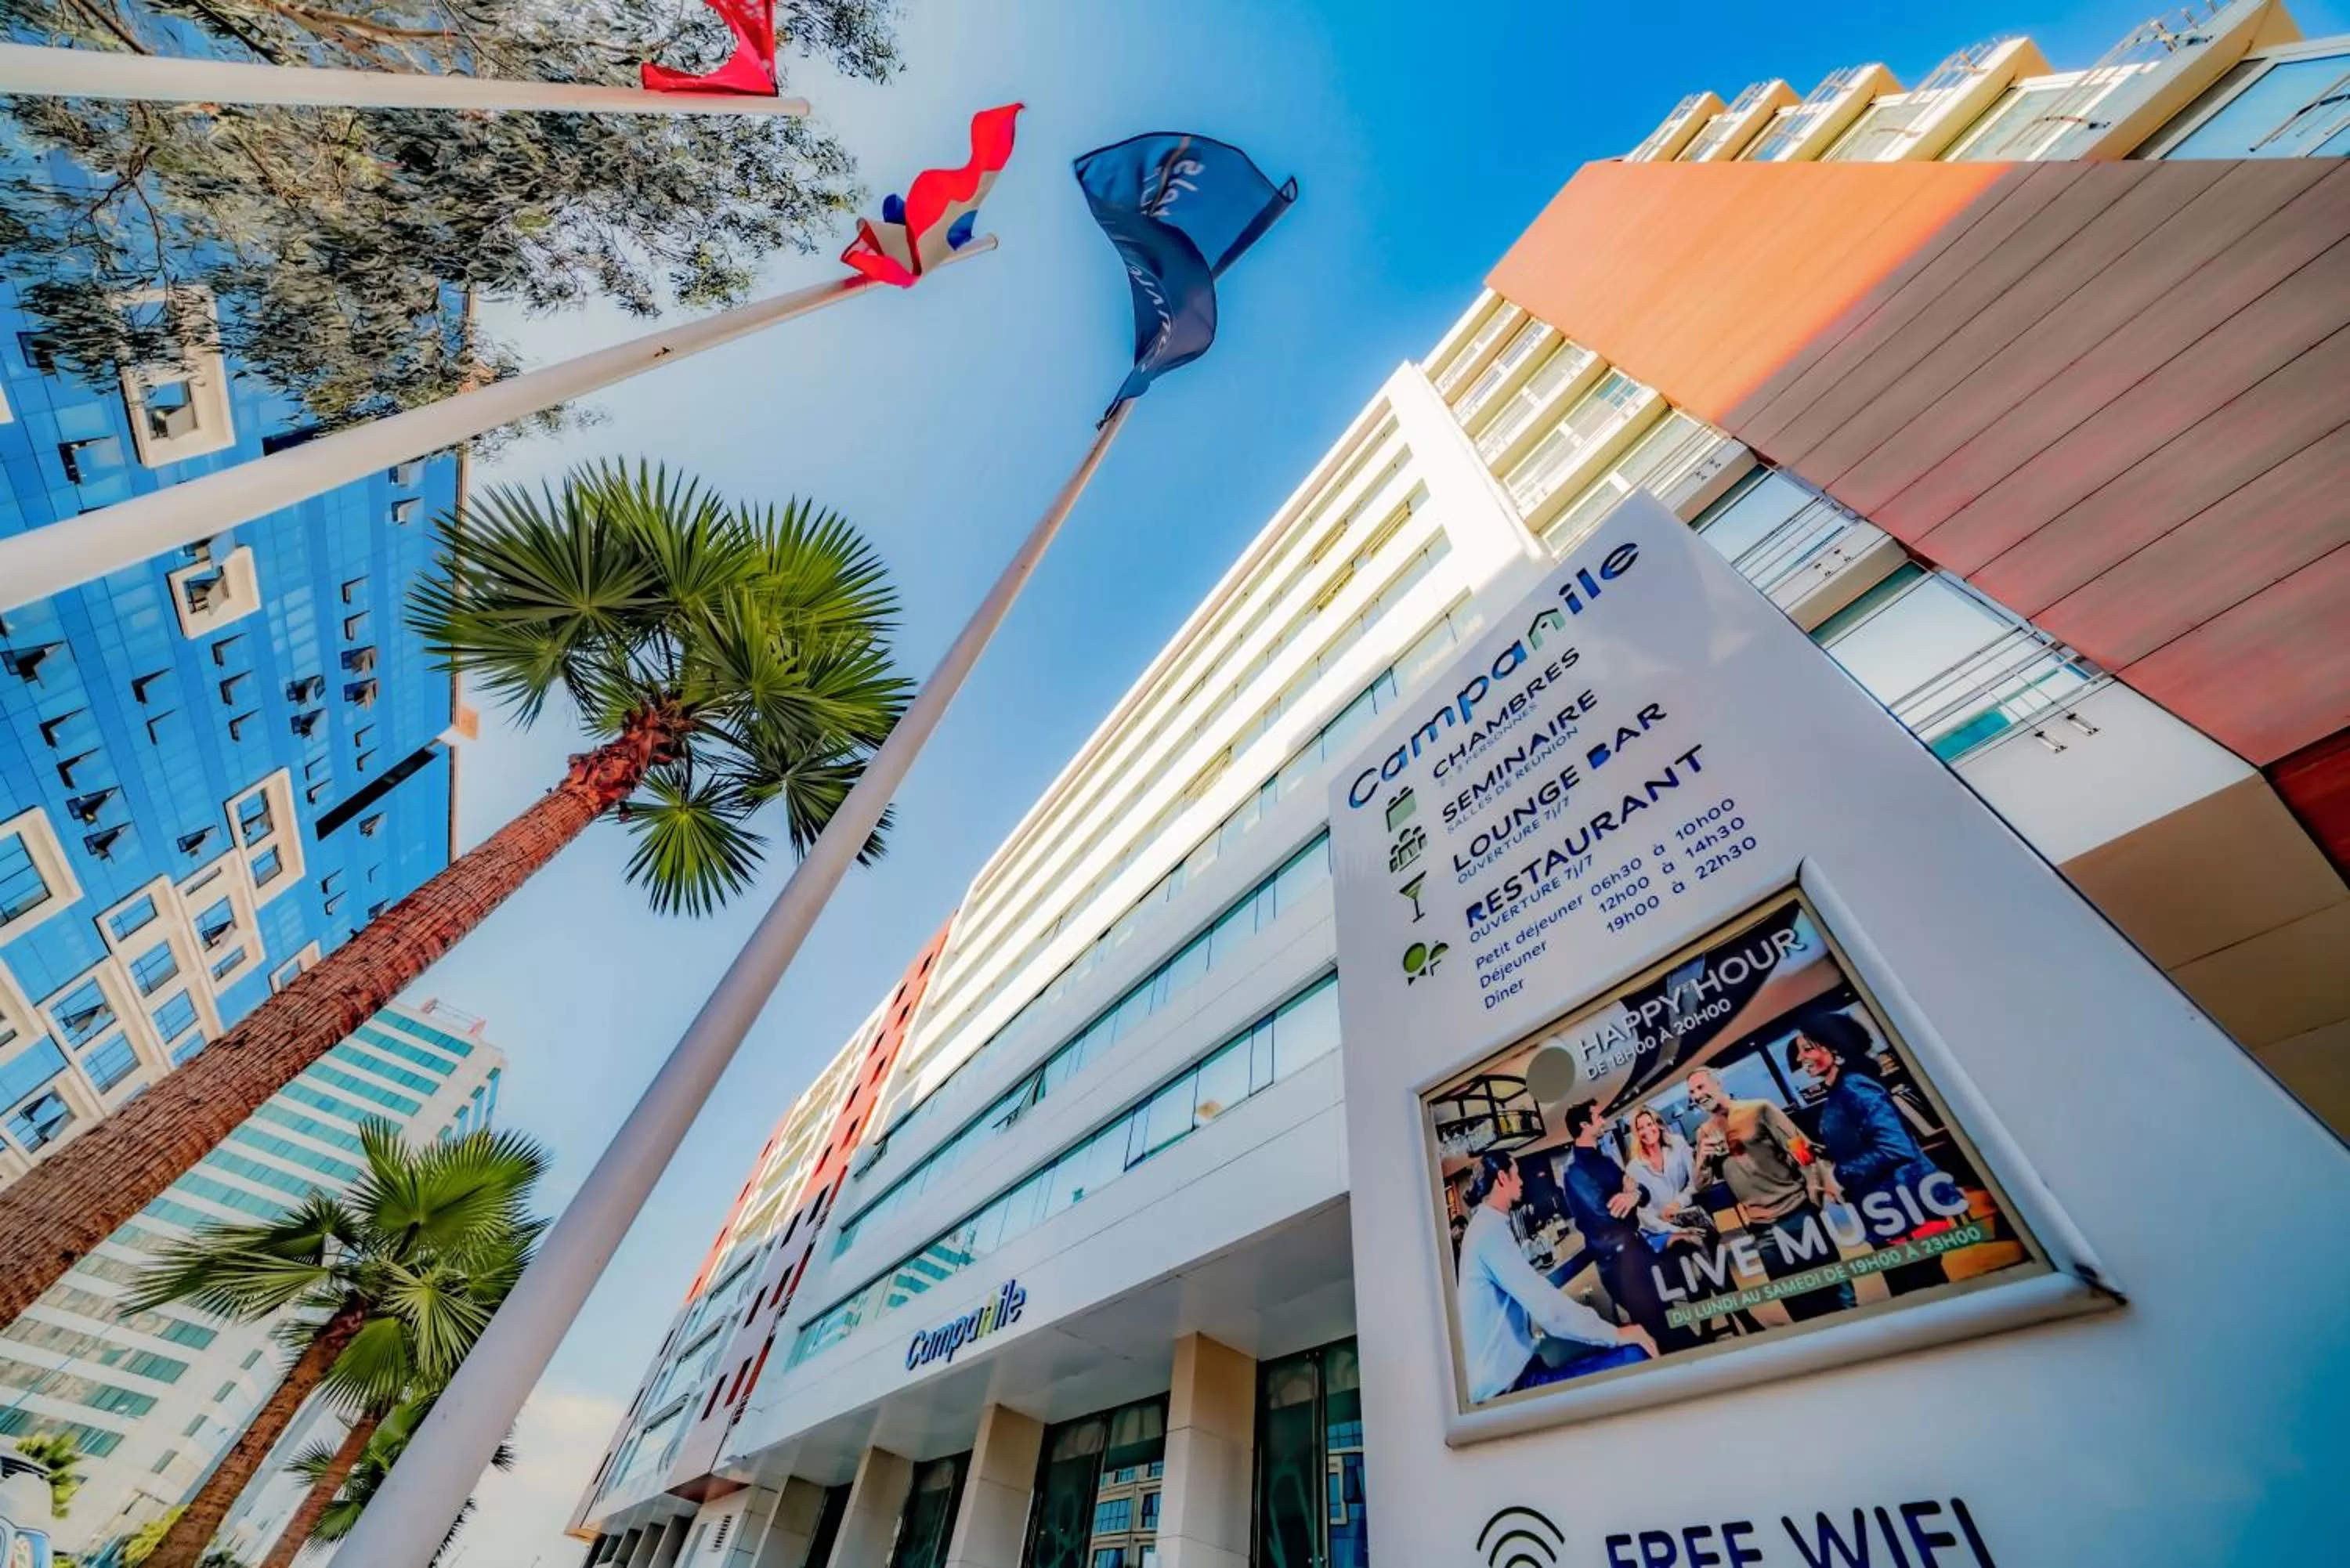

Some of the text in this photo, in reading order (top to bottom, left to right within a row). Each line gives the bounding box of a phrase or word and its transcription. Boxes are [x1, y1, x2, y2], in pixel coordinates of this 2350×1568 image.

[1348, 543, 1640, 809] Campanile
[1433, 647, 1581, 779] CHAMBRES
[1442, 689, 1598, 823] SEMINAIRE
[1447, 791, 1493, 833] SALLES
[1495, 778, 1512, 796] DE
[1453, 703, 1667, 873] LOUNGE BAR
[1457, 819, 1540, 885] OUVERTURE
[1465, 745, 1703, 929] RESTAURANT
[1475, 941, 1510, 970] Petit
[1590, 857, 1643, 897] 06h30
[1653, 843, 1666, 856] à
[1675, 797, 1736, 841] 10h00
[1599, 876, 1650, 914] 12h00
[1662, 861, 1676, 874] à
[1685, 815, 1745, 858] 14h30
[1606, 894, 1661, 934] 19h00
[1672, 880, 1686, 894] à
[1694, 836, 1758, 880] 22h30
[1470, 854, 1593, 943] OUVERTURE 7j/7
[1578, 927, 1806, 1062] HAPPY HOUR
[1586, 1063, 1607, 1082] DE
[1610, 1035, 1657, 1067] 18H00
[1673, 998, 1732, 1036] 20H00
[1650, 1172, 1969, 1303] LIVE MUSIC
[1670, 1309, 1692, 1325] DU
[1695, 1296, 1738, 1318] LUNDI
[1741, 1290, 1761, 1306] AU
[1763, 1274, 1820, 1298] SAMEDI
[1825, 1264, 1847, 1281] DE
[1849, 1249, 1901, 1275] 19H00
[1923, 1226, 1982, 1255] 23H00
[906, 1279, 1027, 1371] Campanile
[1781, 1497, 1996, 1568] WIFI
